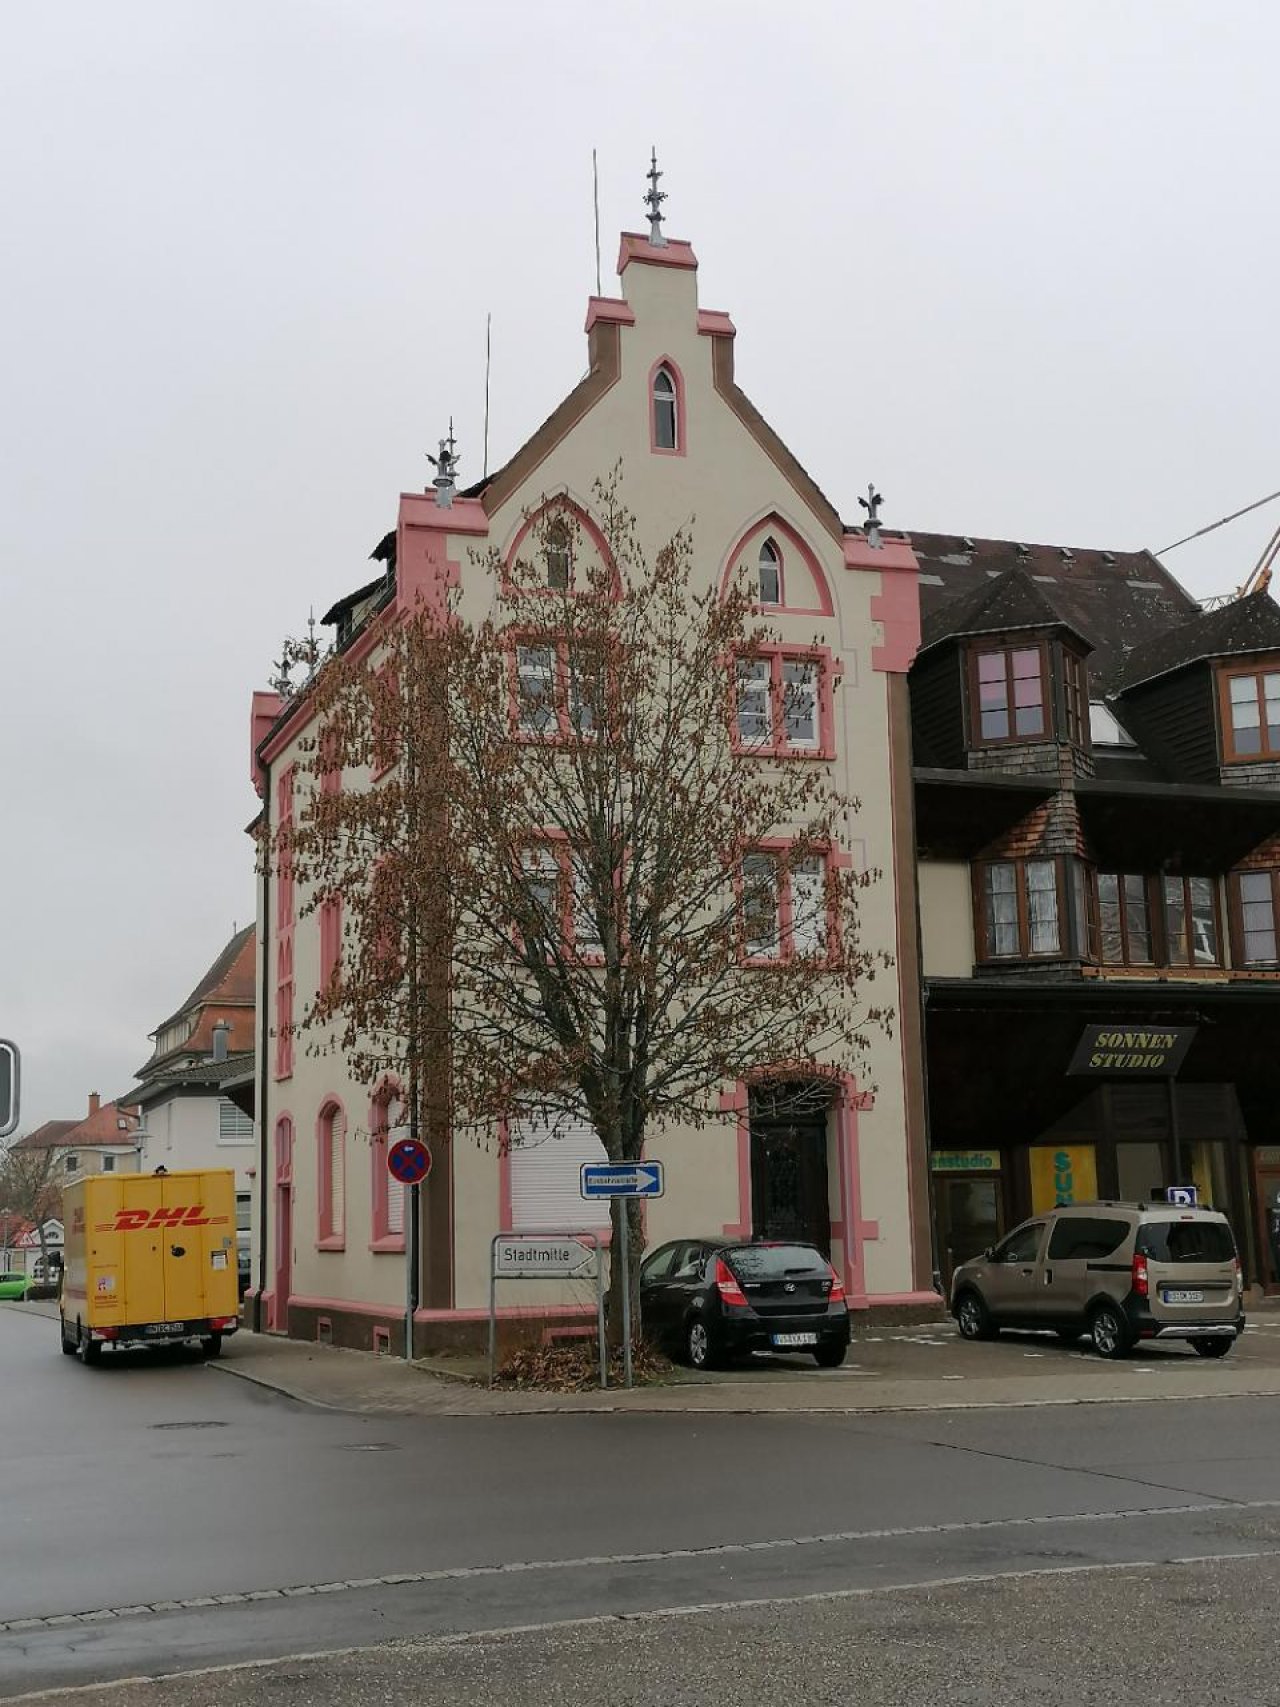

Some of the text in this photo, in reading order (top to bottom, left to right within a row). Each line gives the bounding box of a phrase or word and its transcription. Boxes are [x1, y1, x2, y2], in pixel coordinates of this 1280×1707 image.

[1095, 1033, 1178, 1048] SONNEN
[1089, 1053, 1165, 1068] STUDIO
[114, 1206, 209, 1231] DHL
[504, 1247, 570, 1261] Stadtmitte
